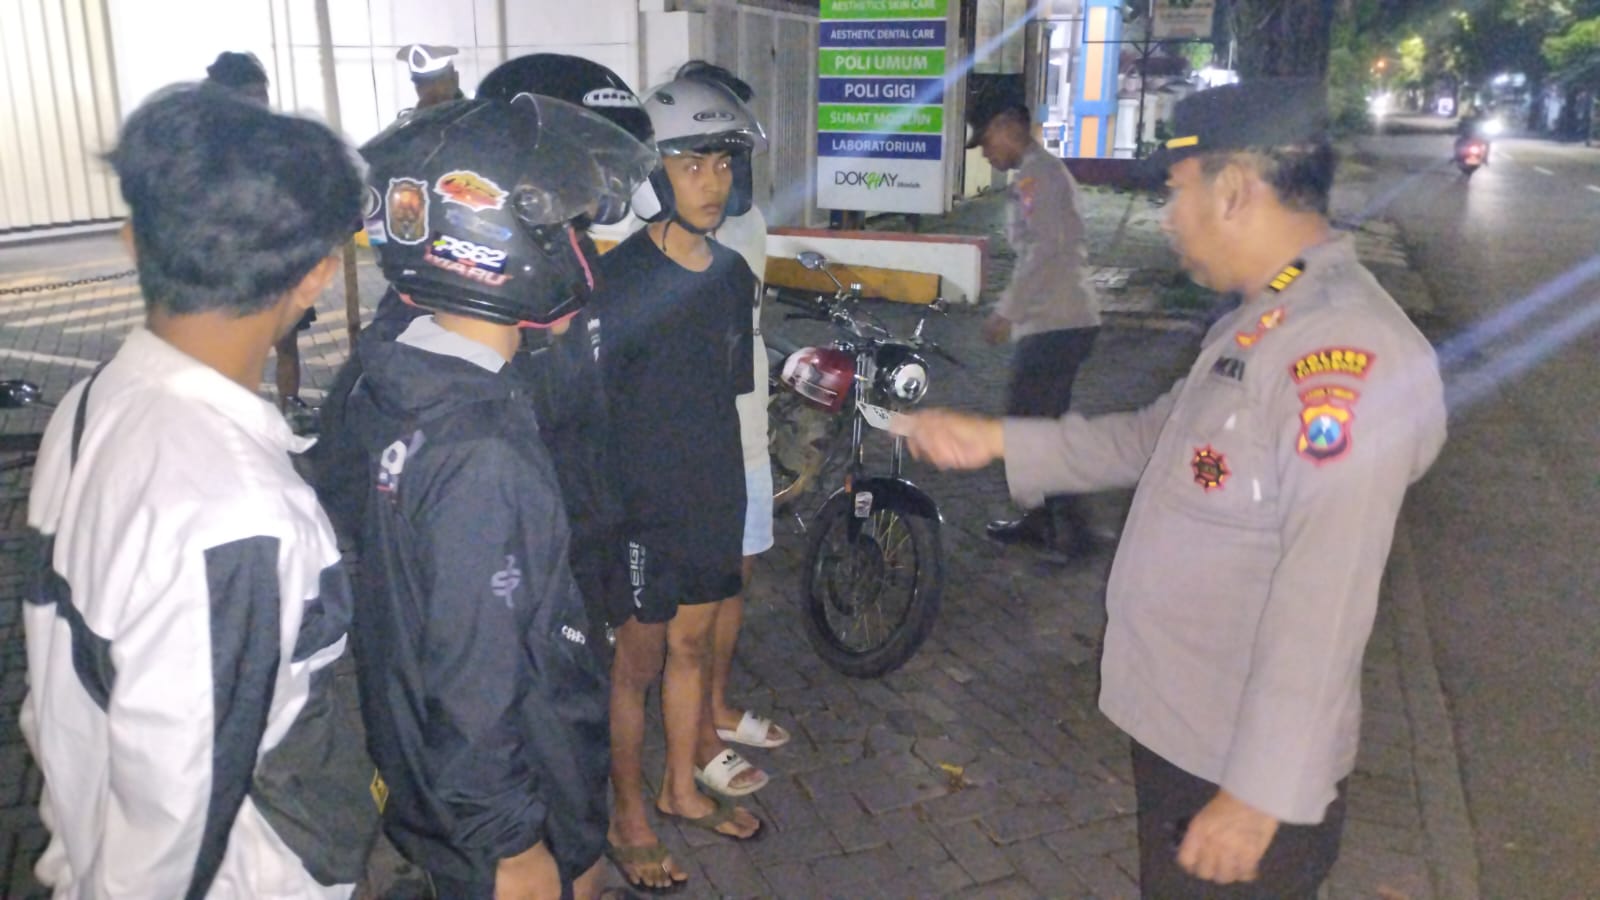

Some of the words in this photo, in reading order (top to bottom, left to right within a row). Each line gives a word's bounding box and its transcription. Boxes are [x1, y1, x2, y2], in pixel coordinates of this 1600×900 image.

[912, 0, 936, 10] CARE
[830, 29, 875, 41] AESTHETIC
[877, 29, 910, 40] DENTAL
[912, 28, 935, 40] CARE
[835, 55, 870, 71] POLI
[874, 55, 928, 71] UMUM
[844, 84, 879, 98] POLI
[882, 83, 916, 99] GIGI
[830, 111, 871, 125] SUNAT
[832, 139, 927, 153] LABORATORIUM
